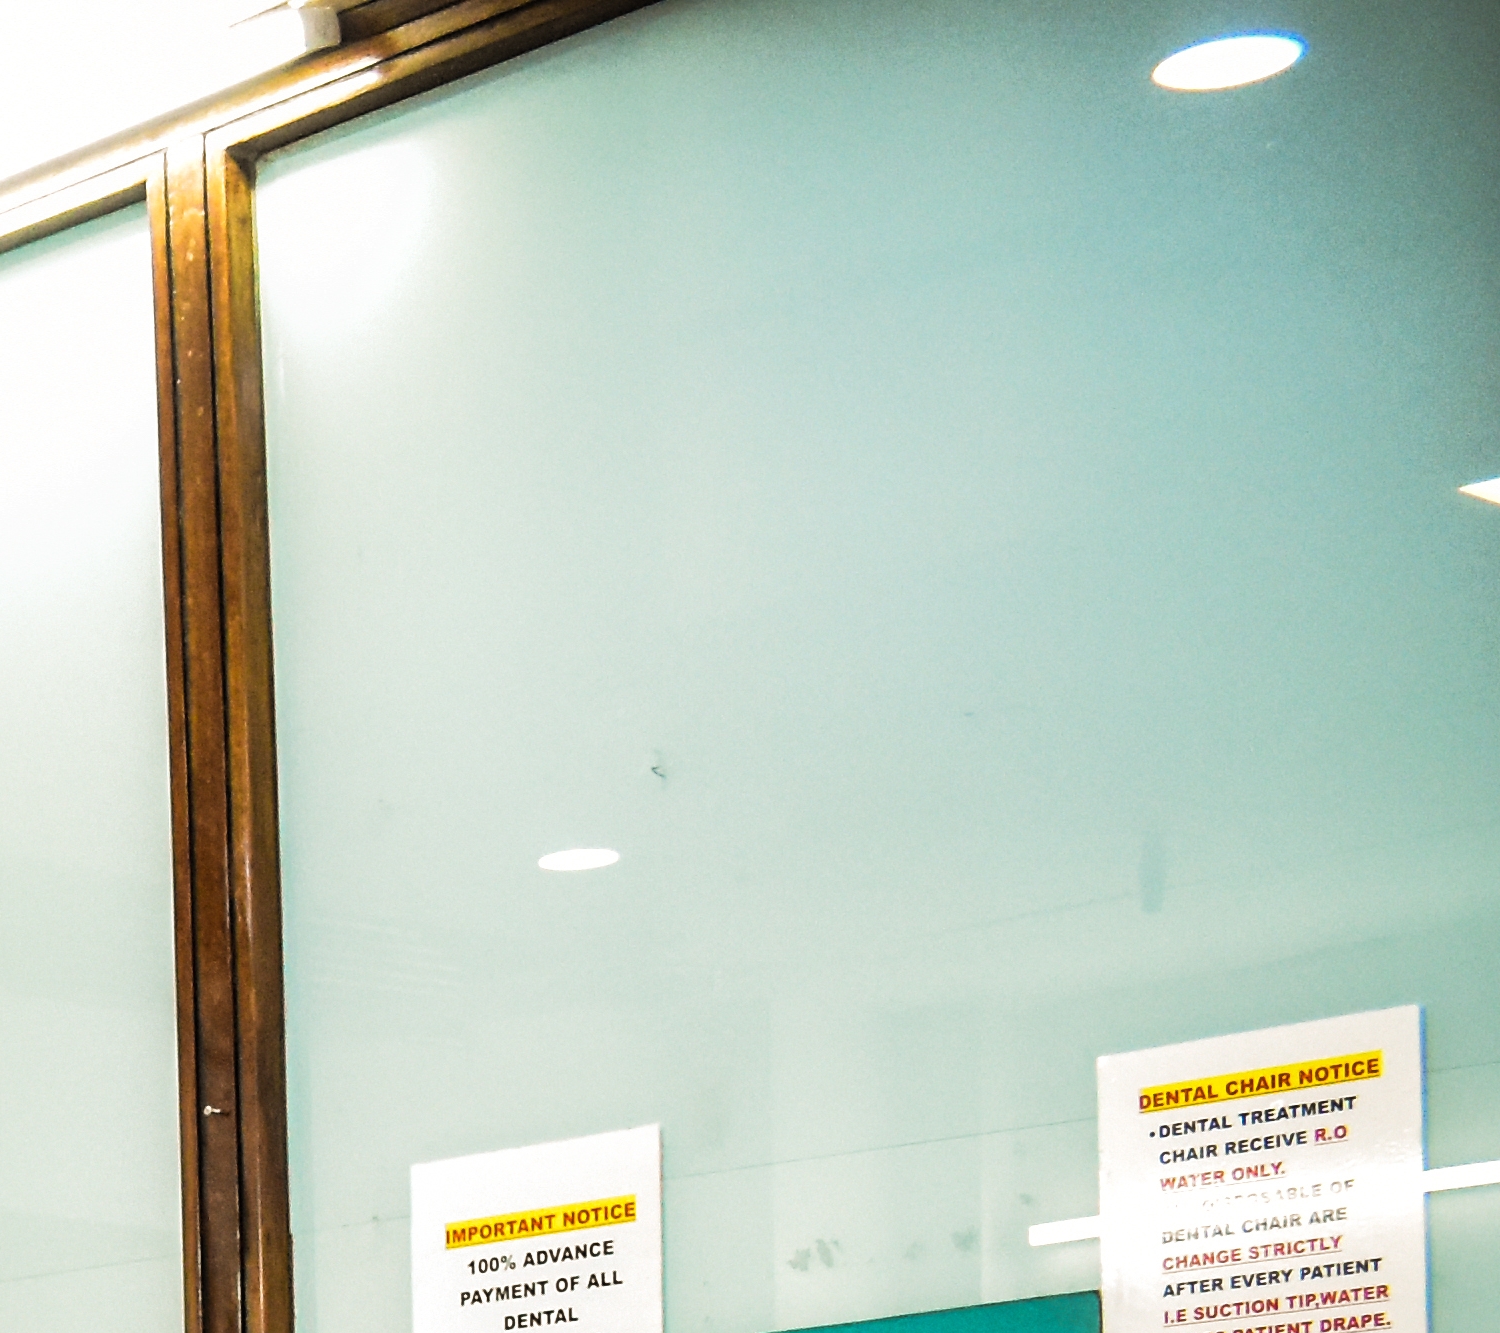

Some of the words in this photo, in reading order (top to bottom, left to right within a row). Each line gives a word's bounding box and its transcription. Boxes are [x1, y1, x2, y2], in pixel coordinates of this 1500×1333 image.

[1140, 1085, 1218, 1109] DENTAL
[1226, 1072, 1293, 1099] CHAIR
[1299, 1058, 1379, 1088] NOTICE
[1160, 1116, 1232, 1138] DENTAL
[1239, 1096, 1356, 1126] TREATMENT
[446, 1214, 555, 1244] IMPORTANT
[563, 1202, 635, 1226] NOTICE
[469, 1255, 516, 1275] 100%
[523, 1240, 613, 1267] ADVANCE
[505, 1308, 578, 1331] DENTAL
